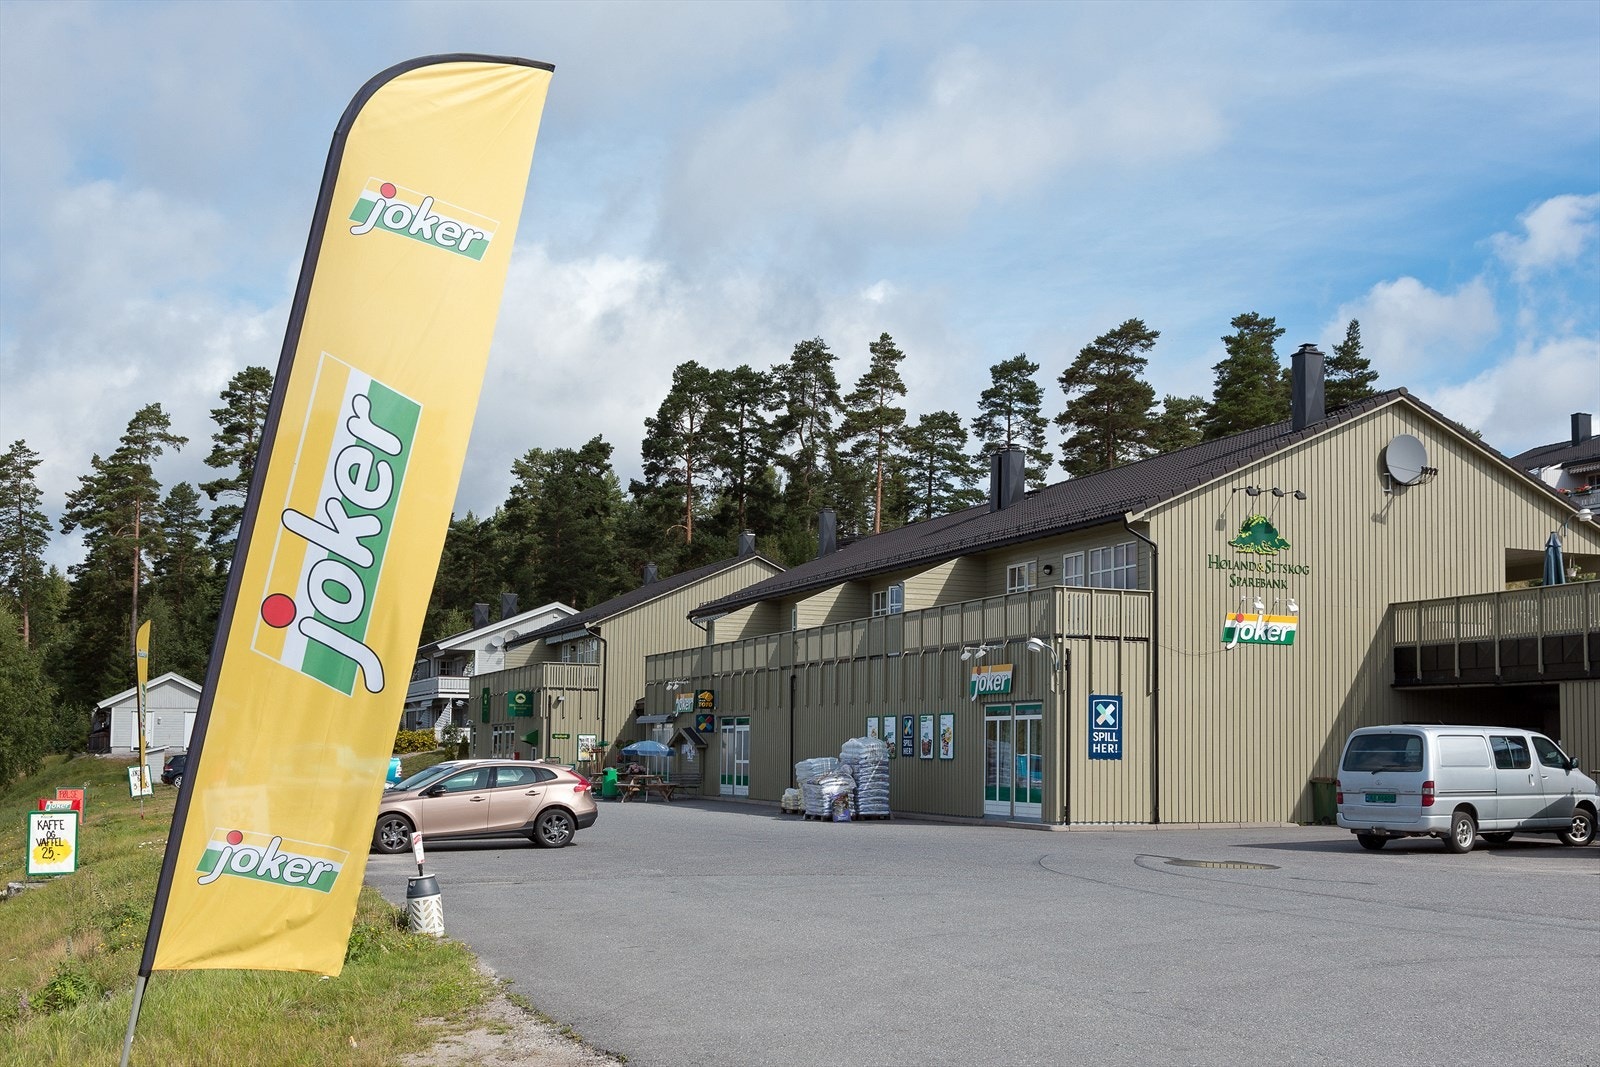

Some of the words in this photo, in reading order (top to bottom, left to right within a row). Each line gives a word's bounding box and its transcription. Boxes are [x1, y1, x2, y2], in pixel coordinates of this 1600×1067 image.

[350, 183, 483, 251] joker
[261, 394, 403, 693] joker
[1226, 610, 1295, 649] joker
[971, 666, 1008, 701] joker
[1093, 732, 1118, 742] SPILL
[1093, 744, 1118, 753] HER!
[46, 801, 70, 812] joker
[37, 819, 65, 830] KAFFE
[46, 830, 56, 839] OG
[36, 837, 64, 847] VAFFEL
[198, 830, 333, 885] joker
